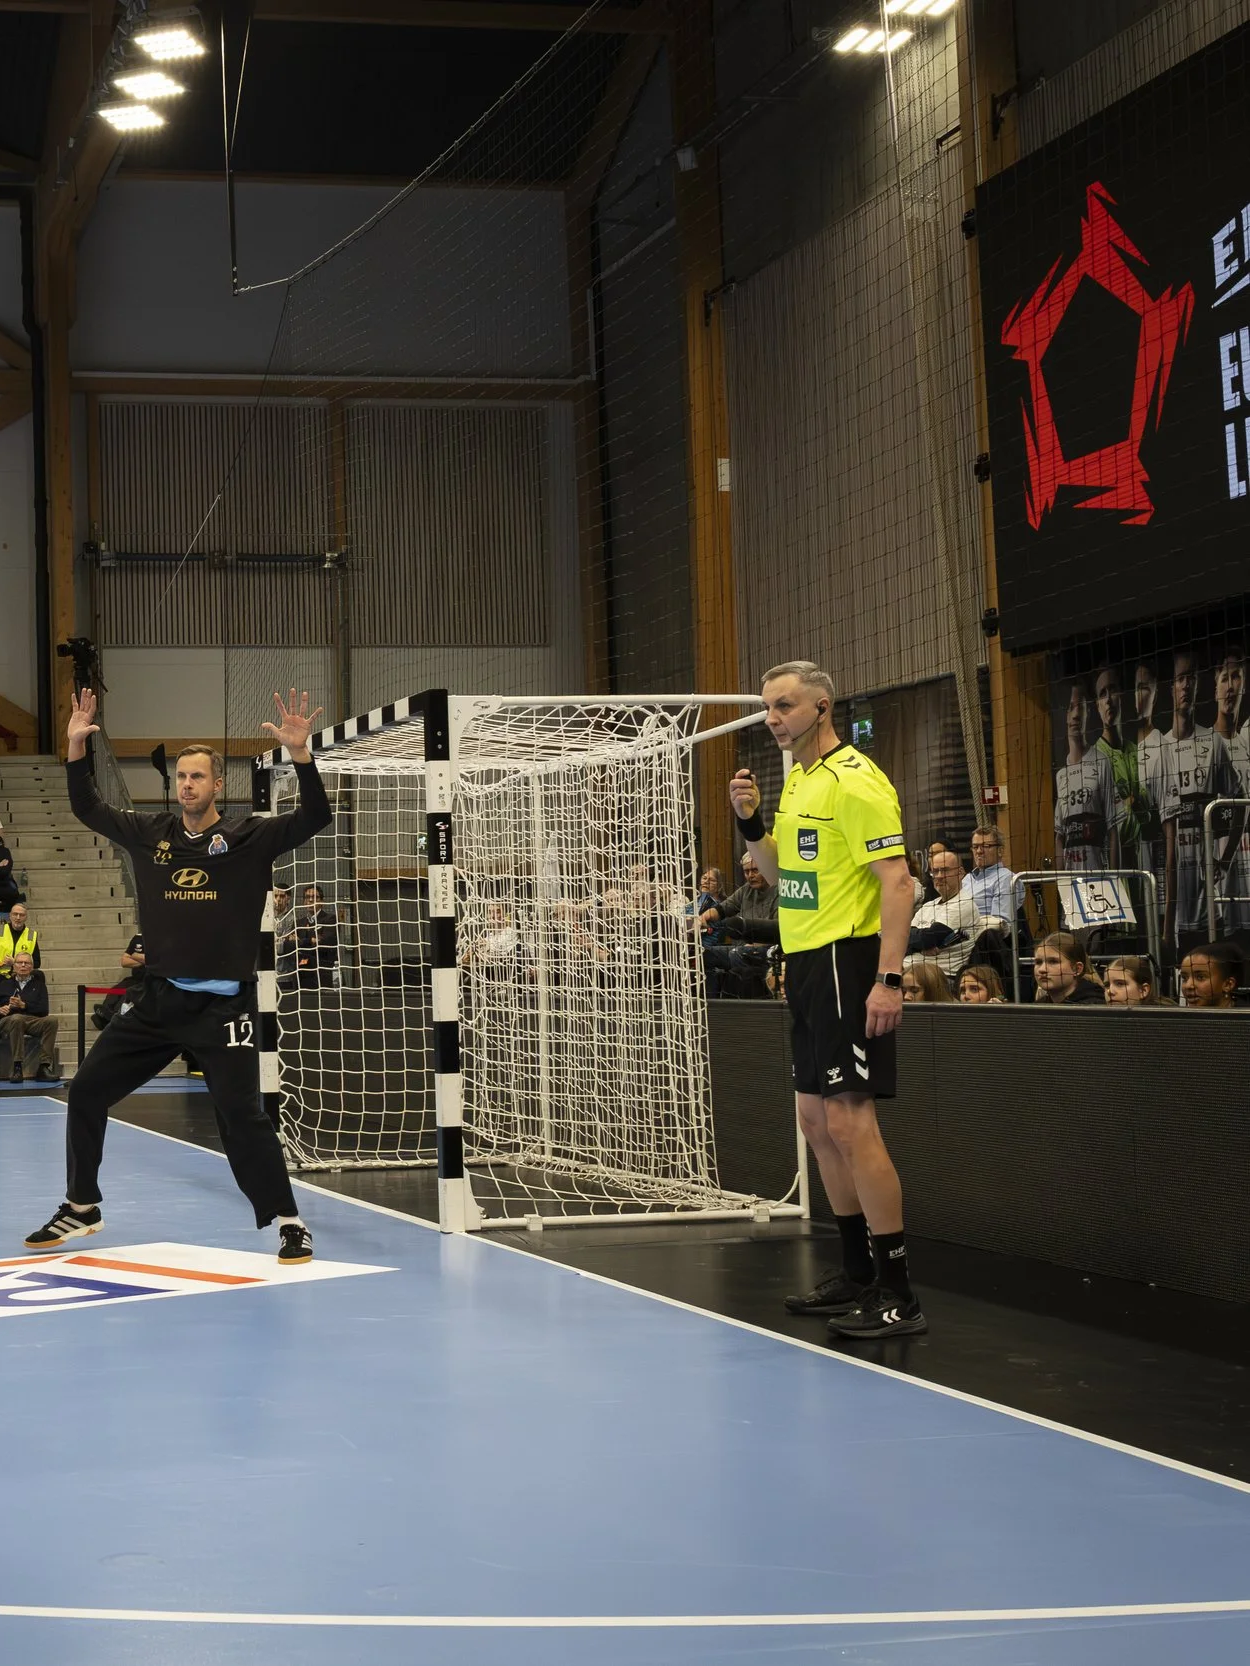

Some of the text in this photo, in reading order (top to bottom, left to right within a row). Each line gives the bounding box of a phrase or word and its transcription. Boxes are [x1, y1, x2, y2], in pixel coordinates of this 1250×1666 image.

[439, 831, 447, 863] SPORT
[799, 834, 817, 844] EHF
[164, 891, 217, 900] HYUNDAI
[223, 1021, 254, 1047] 12
